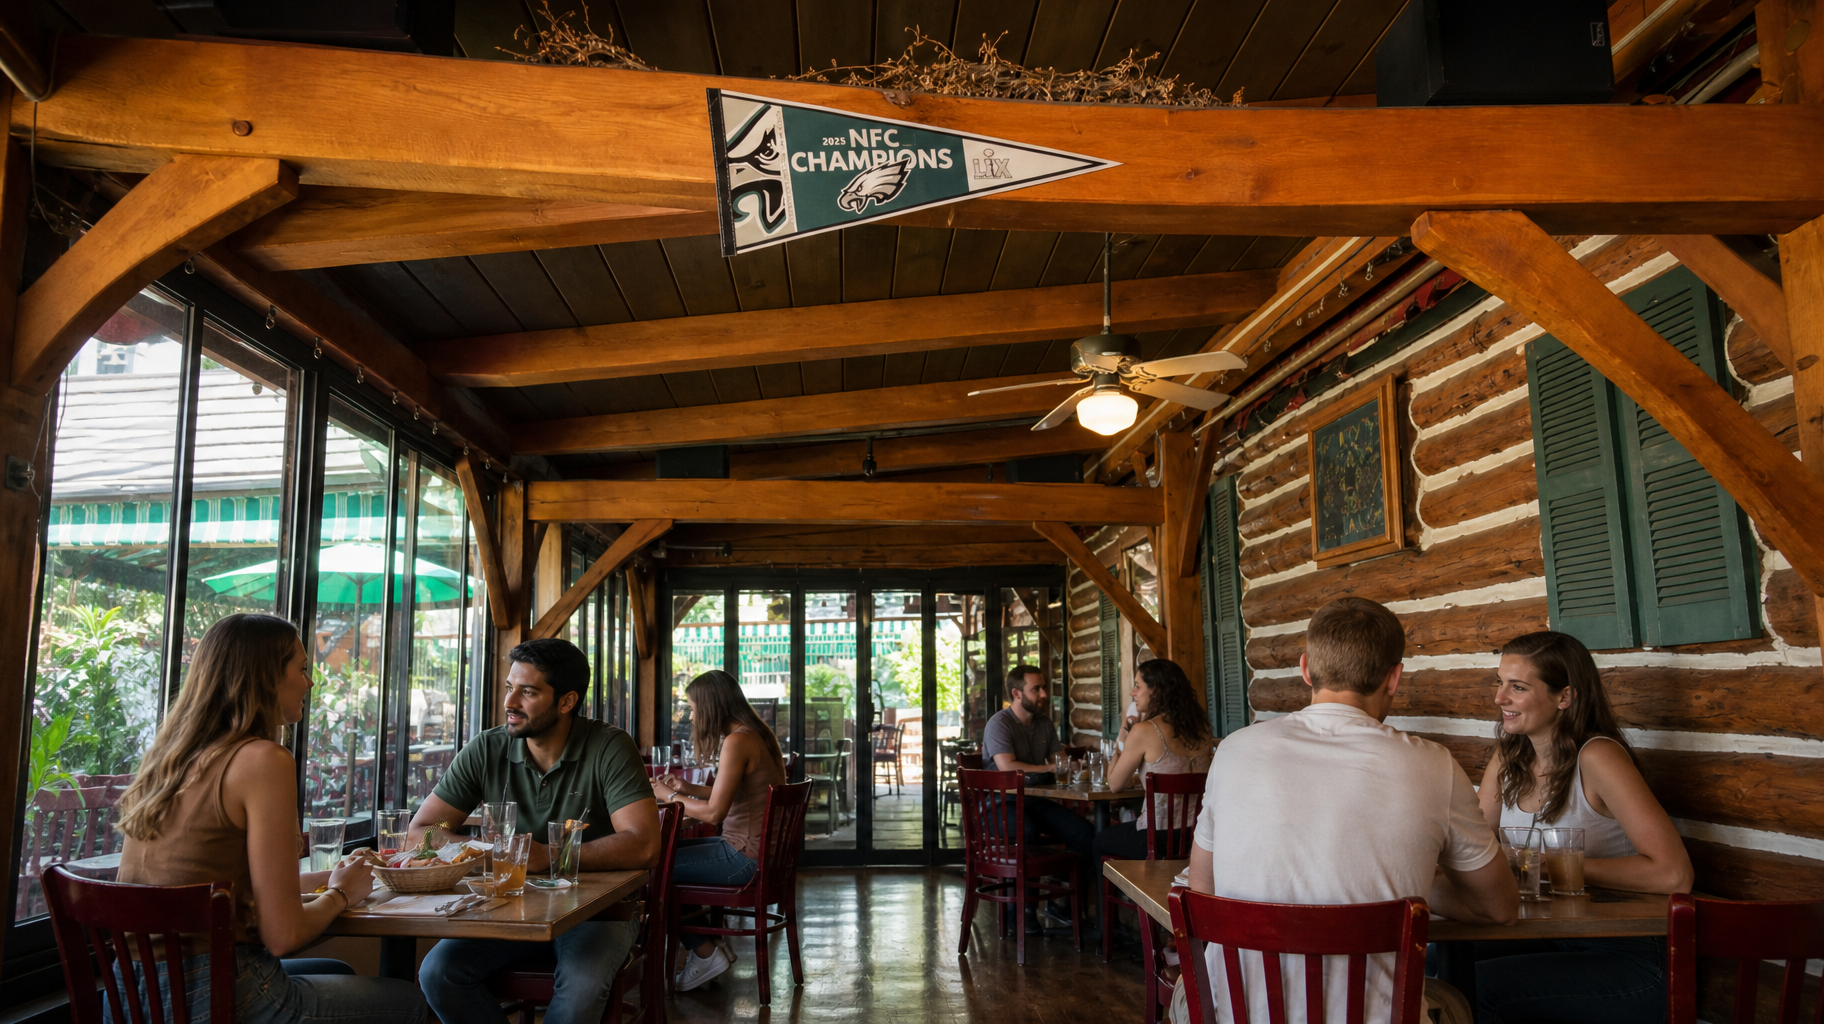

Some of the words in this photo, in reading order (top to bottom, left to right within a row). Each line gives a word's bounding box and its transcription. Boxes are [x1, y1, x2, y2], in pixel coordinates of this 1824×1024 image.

[822, 137, 846, 146] 2025
[849, 128, 900, 148] NFC
[790, 148, 954, 172] CHAMPIONS
